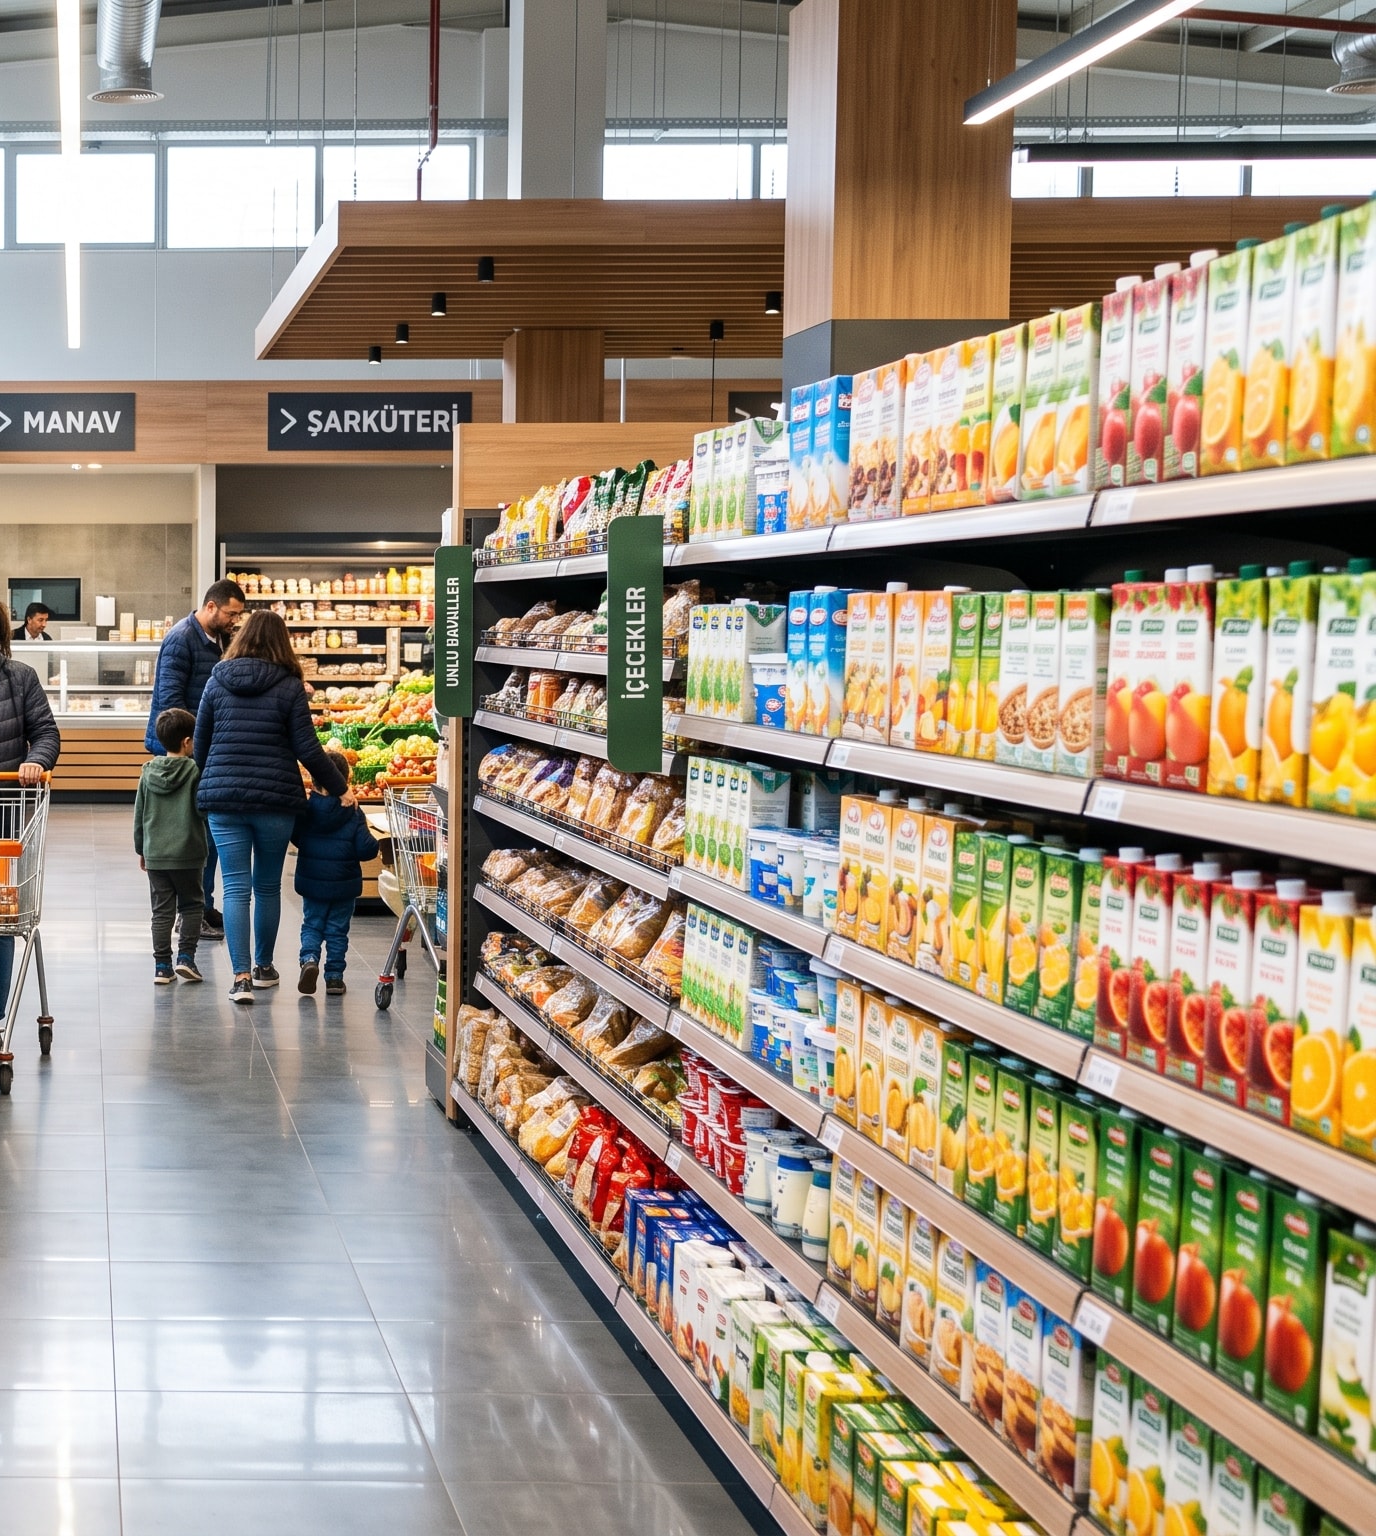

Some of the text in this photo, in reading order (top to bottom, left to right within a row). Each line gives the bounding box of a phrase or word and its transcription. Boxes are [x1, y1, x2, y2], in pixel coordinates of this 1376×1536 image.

[23, 410, 122, 434] MANAV
[307, 403, 459, 437] ŞARKÜTERİ
[620, 586, 650, 699] İÇECEKLER
[446, 650, 459, 687] UNLU
